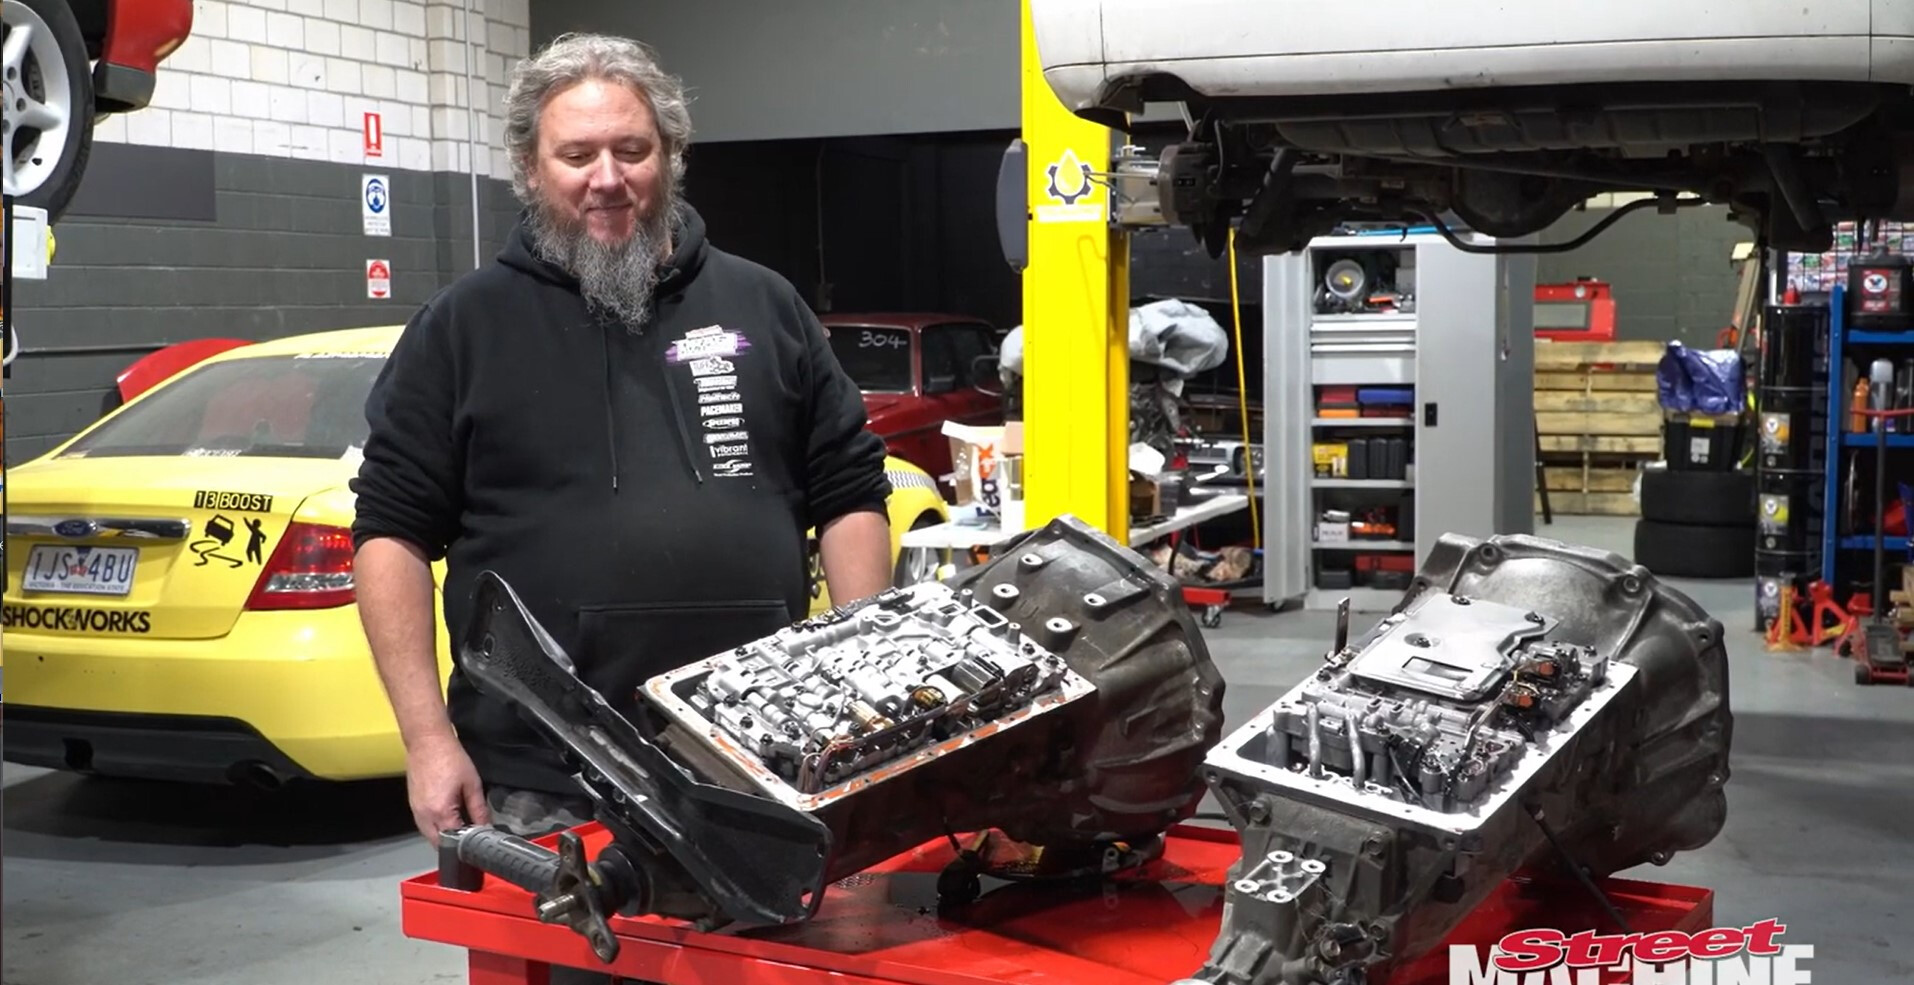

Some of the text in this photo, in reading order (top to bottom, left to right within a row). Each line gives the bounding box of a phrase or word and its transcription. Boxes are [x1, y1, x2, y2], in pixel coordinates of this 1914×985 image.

[859, 331, 907, 349] 304
[701, 402, 743, 416] PACEMAKER
[219, 492, 272, 511] BOOST
[33, 551, 133, 583] 1JS 4BU
